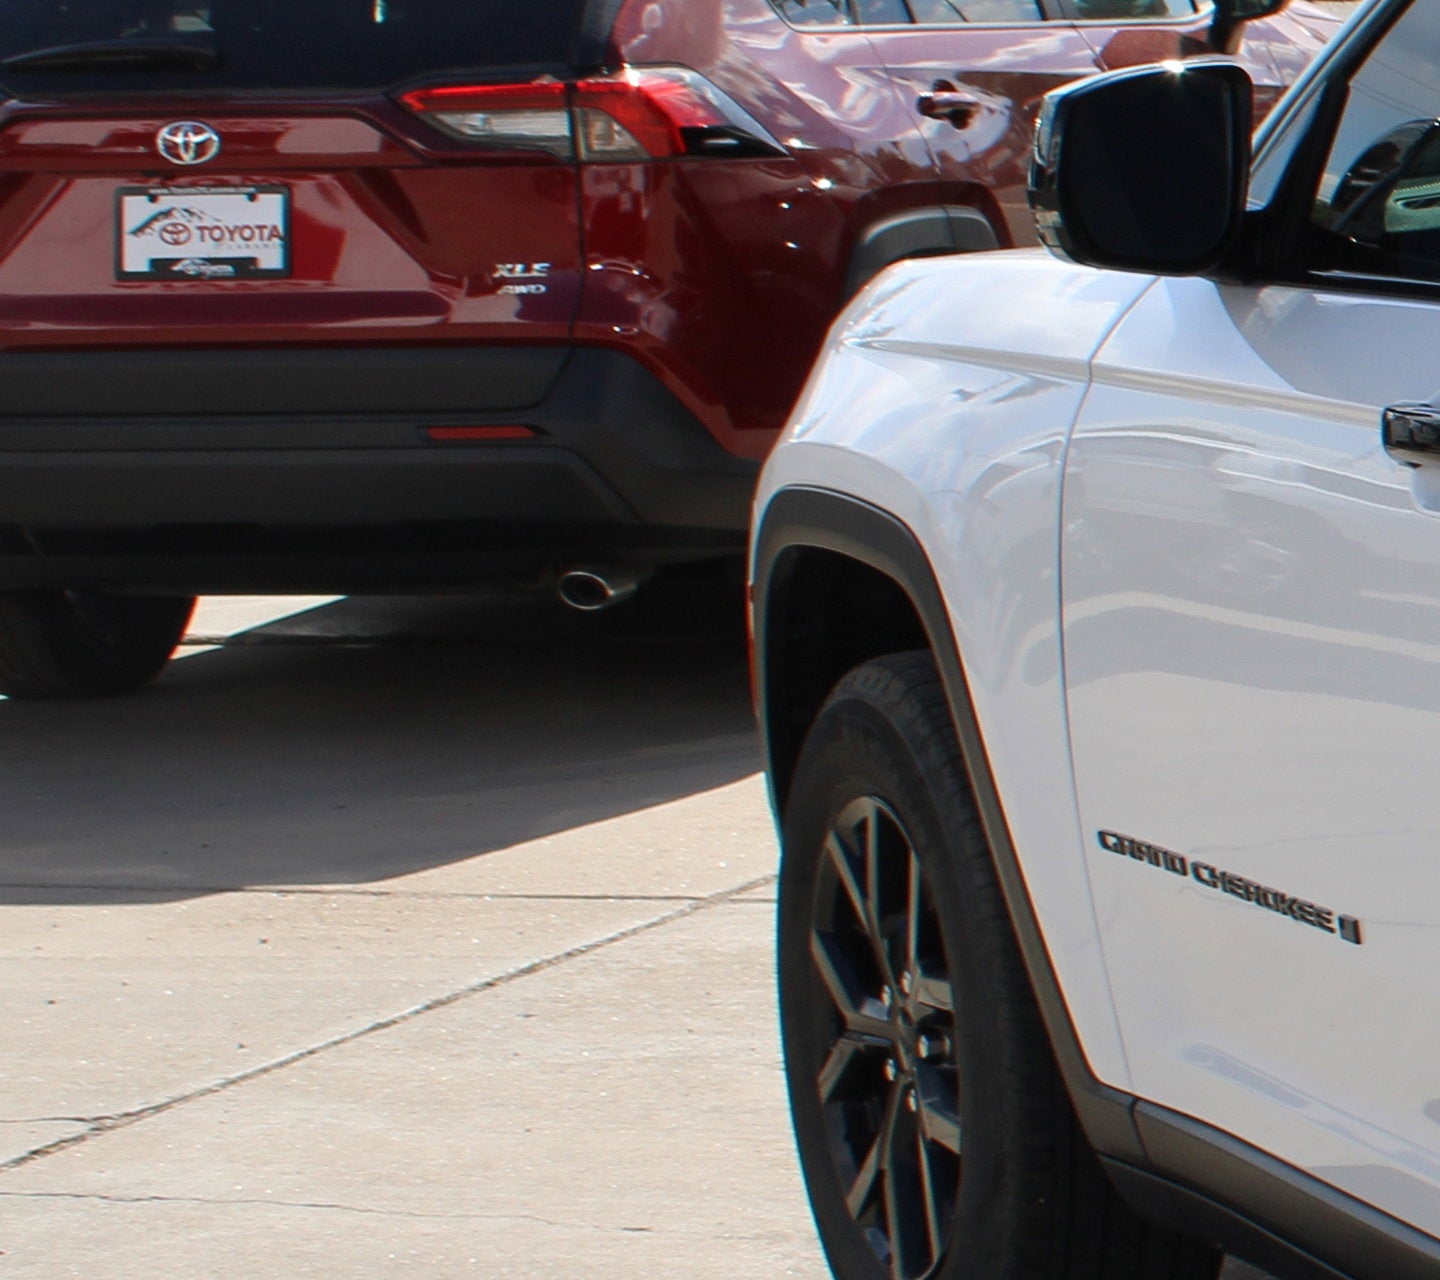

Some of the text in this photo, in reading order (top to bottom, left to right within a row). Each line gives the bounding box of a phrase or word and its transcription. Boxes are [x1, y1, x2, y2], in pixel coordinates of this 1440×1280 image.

[195, 224, 284, 243] TOYOTA
[492, 262, 551, 278] XLE
[1097, 828, 1337, 935] GRAND CHEROKEE
